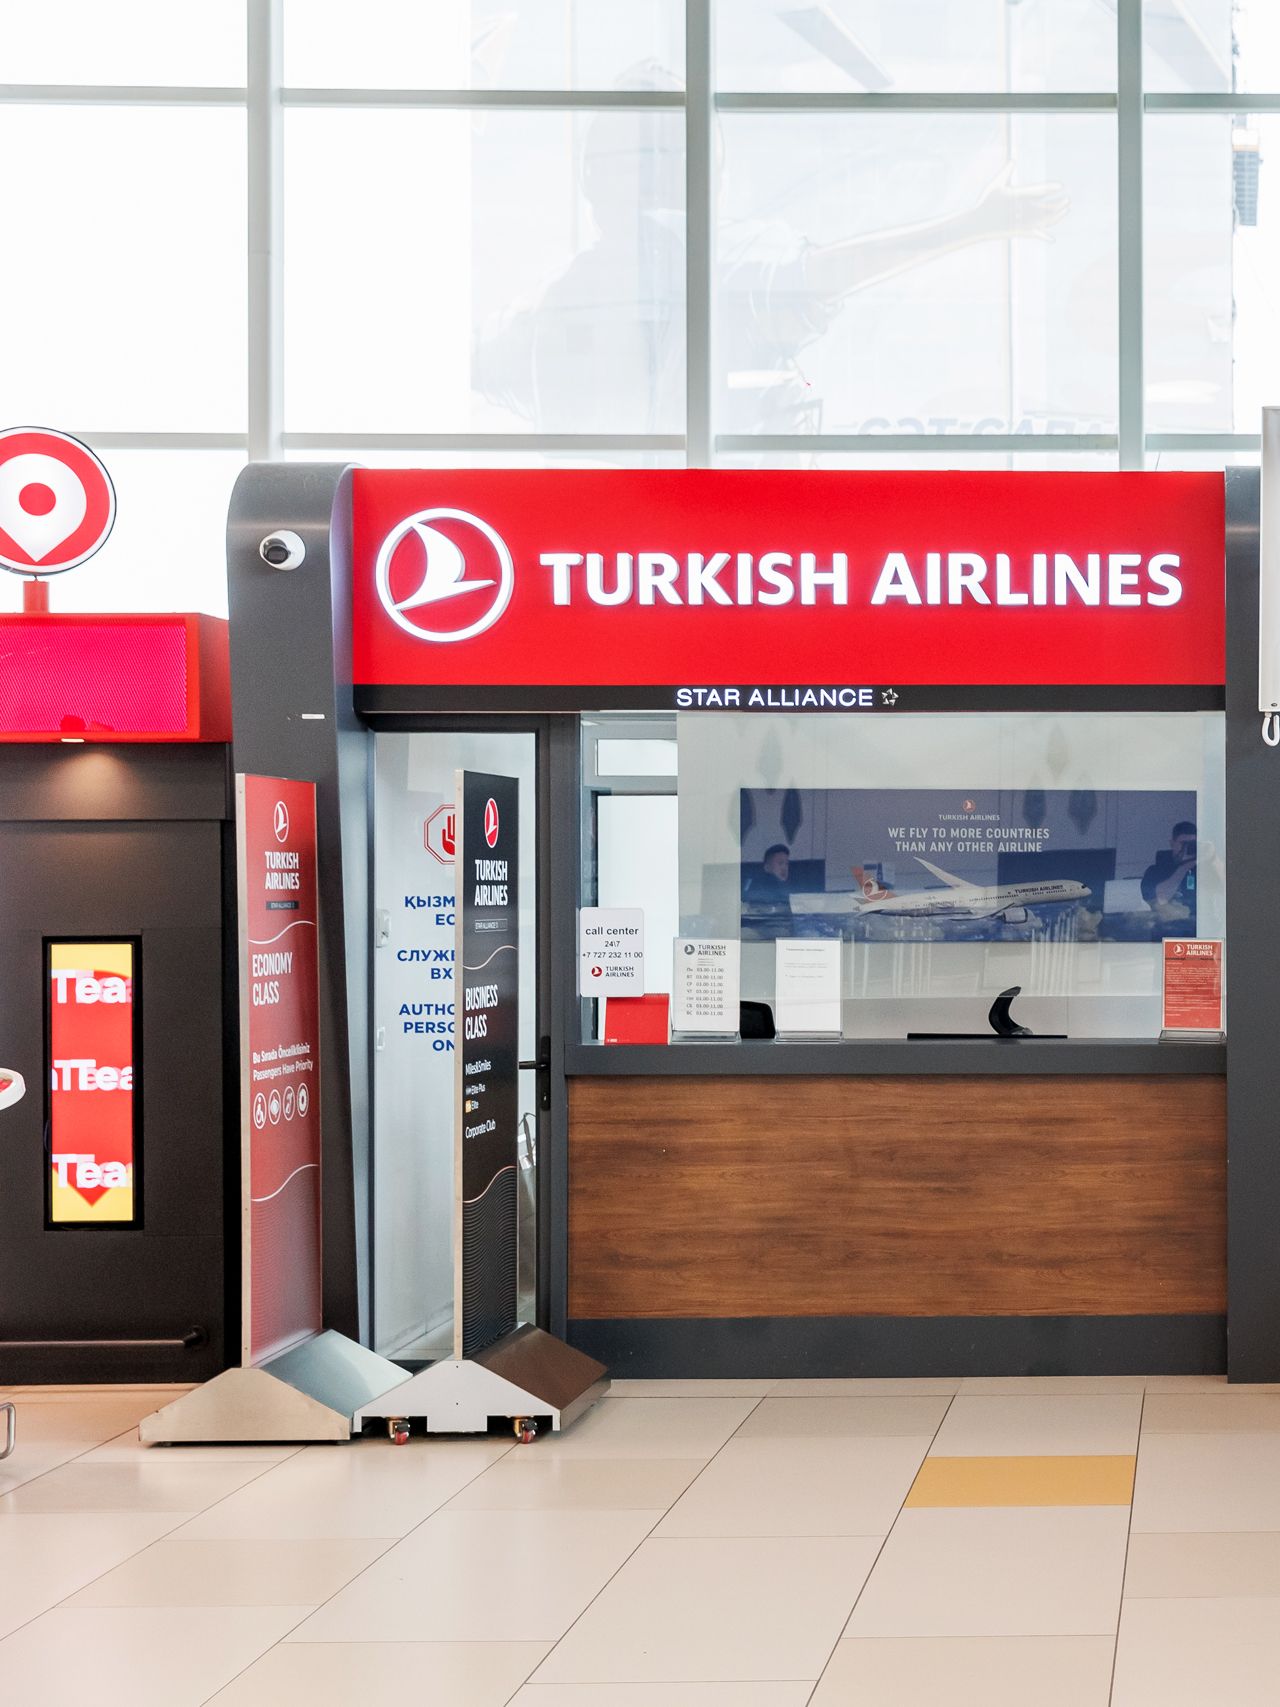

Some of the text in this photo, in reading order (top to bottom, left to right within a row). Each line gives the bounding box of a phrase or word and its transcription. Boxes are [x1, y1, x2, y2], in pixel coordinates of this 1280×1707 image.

[539, 551, 1183, 607] TURKISH AIRLINES
[676, 687, 874, 707] STAR ALLIANCE
[888, 827, 1050, 839] WE FLY TO MORE COUNTRIES
[895, 841, 1043, 852] THAN ANY OTHER AIRLINE
[265, 851, 299, 869] TURKISH
[475, 859, 508, 881] TURKISH
[265, 872, 300, 890] AIRLINES
[474, 885, 508, 906] AIRLINES
[585, 926, 639, 936] call center
[604, 940, 621, 948] 24\7
[252, 952, 293, 978] ECONOMY
[253, 981, 280, 1007] CLASS
[465, 984, 498, 1011] BUSINESS
[465, 1014, 487, 1040] CLASS
[253, 1052, 261, 1064] Bu
[253, 1059, 313, 1082] Passengers Have Priority
[465, 1118, 497, 1139] Corporate Club
